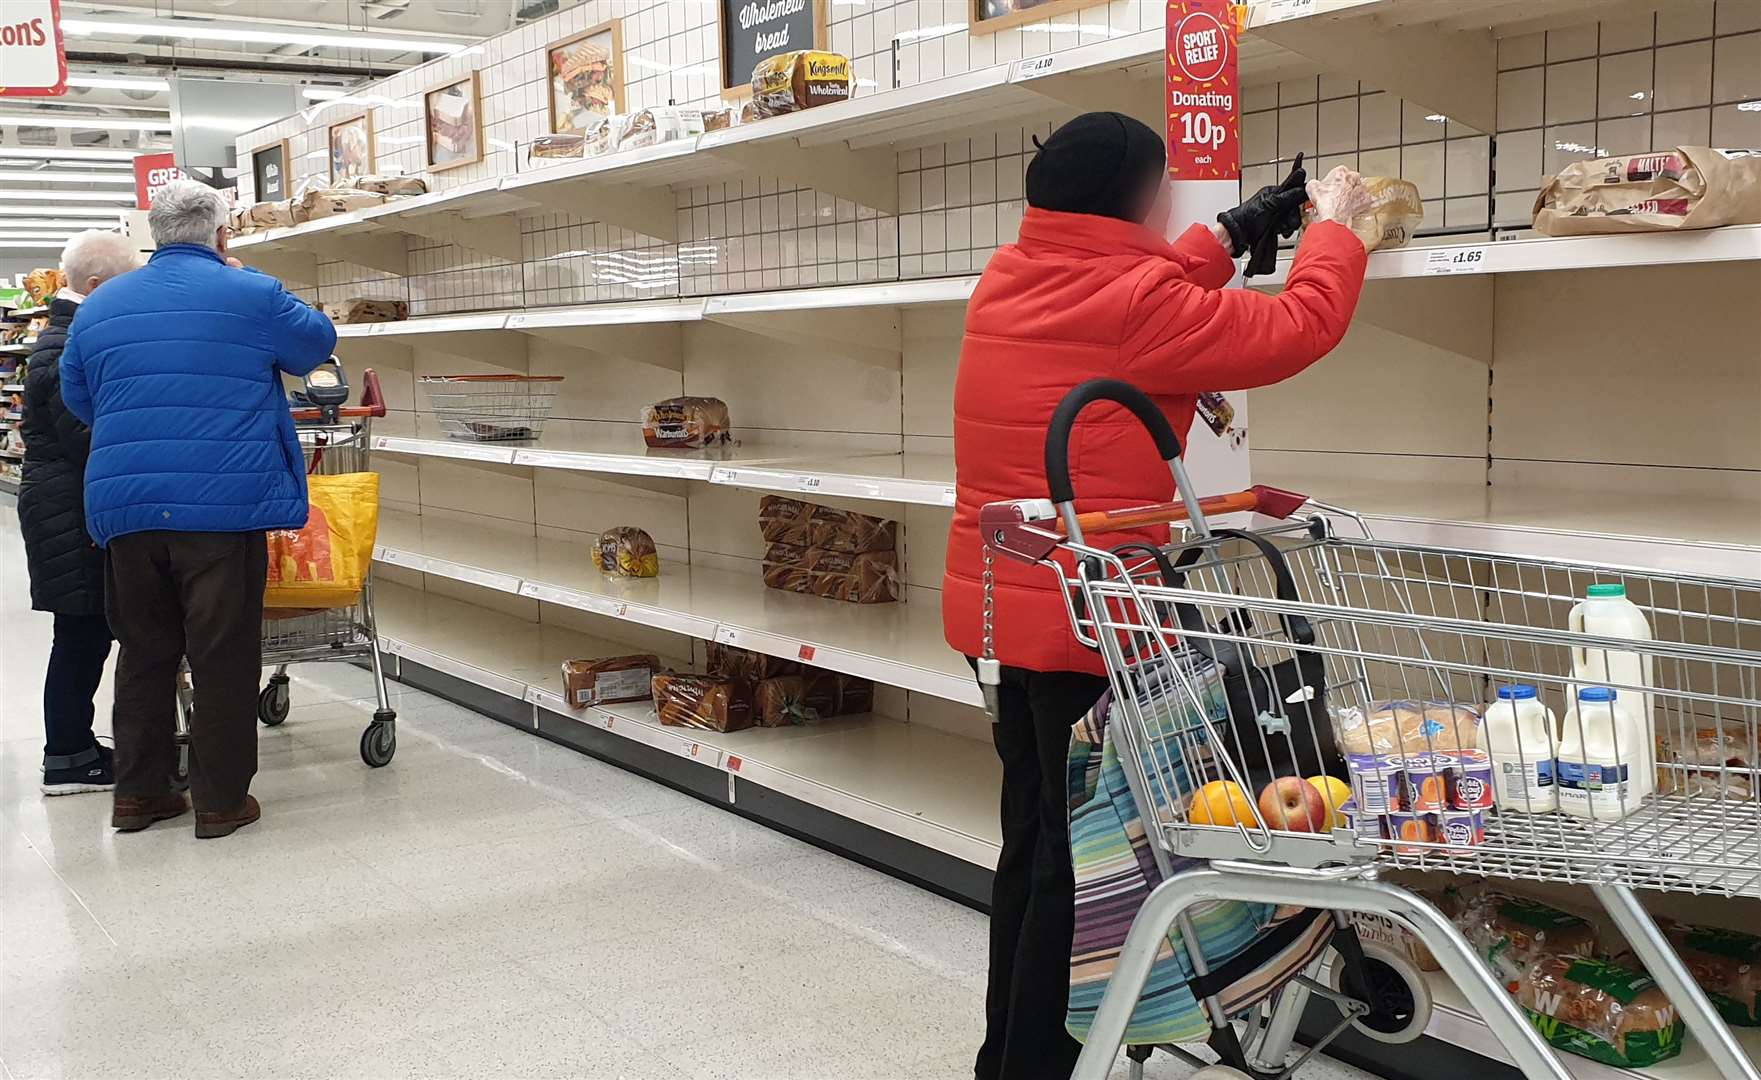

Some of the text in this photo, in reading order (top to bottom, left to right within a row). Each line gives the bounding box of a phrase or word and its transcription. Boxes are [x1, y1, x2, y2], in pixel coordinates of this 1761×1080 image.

[755, 24, 790, 54] bread
[1183, 29, 1217, 49] SPORT
[1185, 45, 1219, 66] RELIEF
[808, 60, 847, 77] Kingsmill
[809, 85, 849, 96] Wholemeal
[1172, 91, 1233, 110] Donating
[1180, 112, 1226, 150] 10p
[1195, 154, 1212, 164] each
[1637, 156, 1670, 177] MALTE
[148, 167, 189, 185] GREA
[1453, 250, 1482, 263] £1.65
